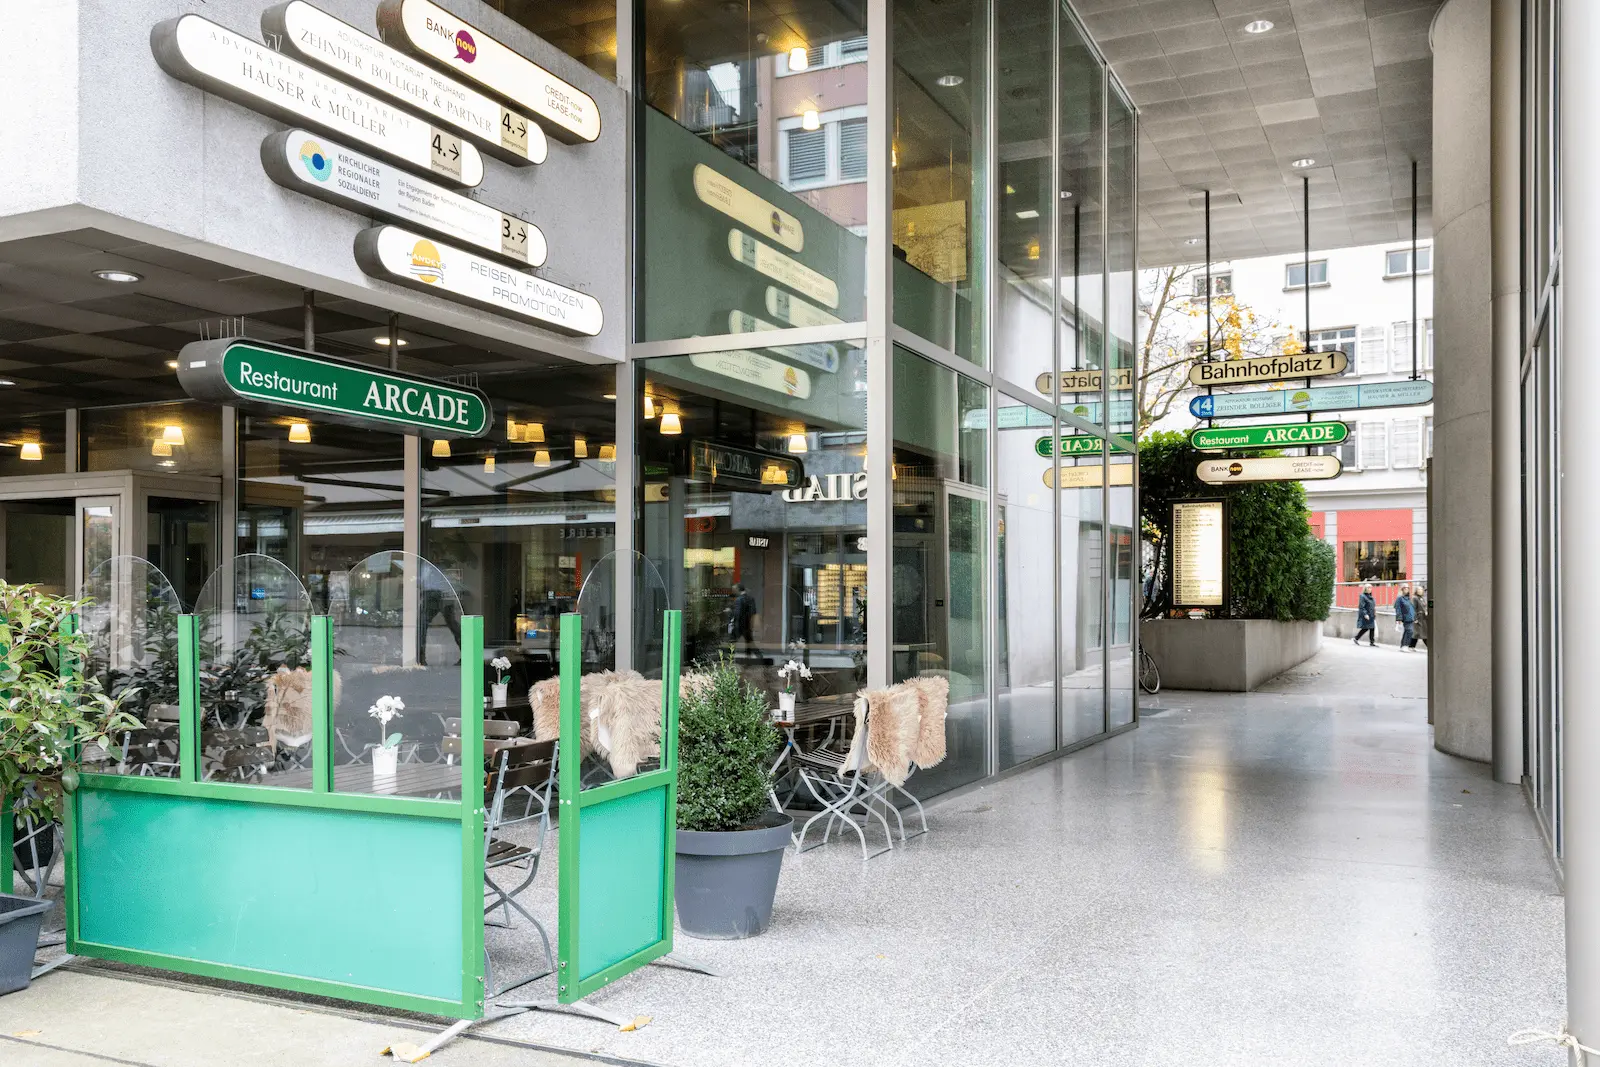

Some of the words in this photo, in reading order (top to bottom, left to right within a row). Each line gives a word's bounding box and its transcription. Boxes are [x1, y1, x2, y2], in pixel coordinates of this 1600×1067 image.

[426, 17, 454, 43] BANK
[456, 38, 476, 55] now
[338, 30, 385, 60] ADVOKATUR
[390, 57, 424, 79] NOTARIAT
[429, 76, 466, 101] TREUHAND
[209, 31, 305, 80] ADVOKATUR
[346, 93, 411, 129] NOTARIAT
[300, 28, 363, 69] ZEHNDER
[372, 63, 429, 102] BOLLIGER
[433, 95, 442, 109] &
[447, 101, 491, 132] PARTNER
[242, 62, 305, 101] HAUSER
[311, 94, 321, 109] &
[328, 100, 386, 137] MÜLLER
[502, 113, 515, 134] 4.
[432, 134, 446, 157] 4.
[338, 153, 380, 176] KIRCHLICHER
[338, 166, 380, 189] REGIONALER
[338, 179, 380, 200] SOZIALDIENST
[502, 218, 515, 240] 3.
[470, 262, 517, 287] REISEN
[526, 281, 584, 309] FINANZEN
[492, 287, 566, 319] PROMOTION
[1201, 357, 1322, 381] Bahnhofplatz
[1327, 353, 1336, 369] 1
[240, 361, 338, 400] Restaurant
[363, 381, 469, 426] ARCADE
[1200, 397, 1213, 411] 4
[1216, 404, 1247, 412] ZEHNDER
[1249, 402, 1282, 410] BOLLIGER
[1200, 435, 1249, 446] Restaurant
[1263, 426, 1335, 443] ARCADE
